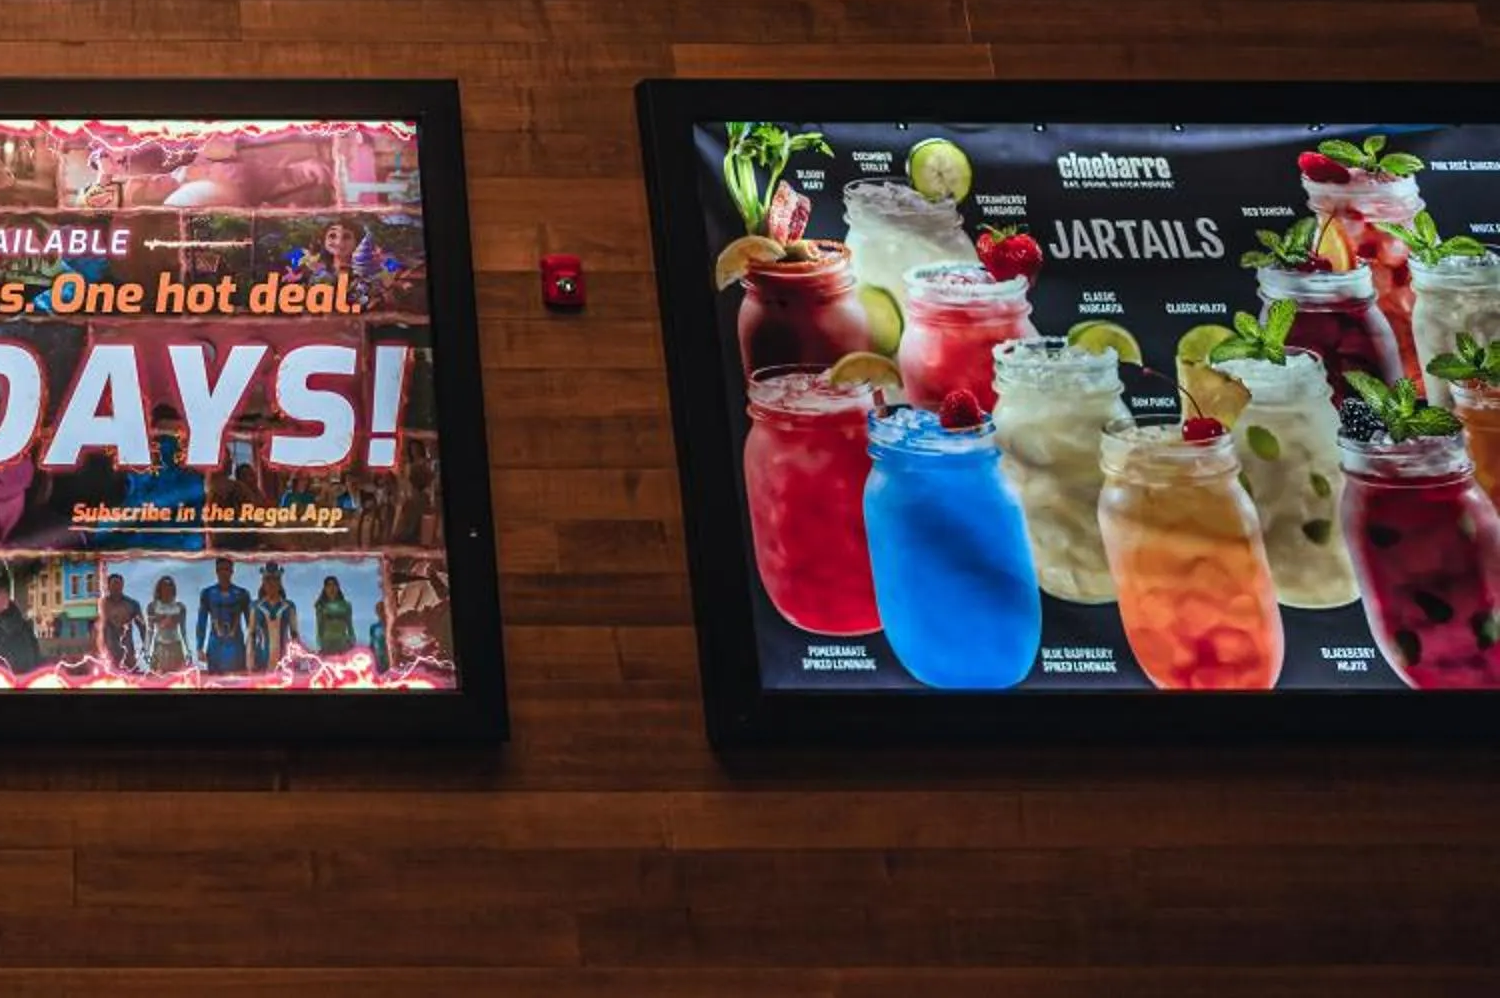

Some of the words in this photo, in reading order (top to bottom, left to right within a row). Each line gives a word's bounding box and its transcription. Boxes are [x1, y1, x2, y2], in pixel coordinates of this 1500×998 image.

[1057, 151, 1173, 180] cinebarre
[1049, 216, 1226, 260] JARTAILS
[51, 272, 144, 314] One
[155, 271, 237, 314] hot
[249, 271, 362, 315] deal.
[72, 502, 172, 523] Subscribe
[175, 503, 196, 523] in
[201, 503, 236, 523] the
[238, 503, 298, 528] Regal
[299, 503, 343, 528] App
